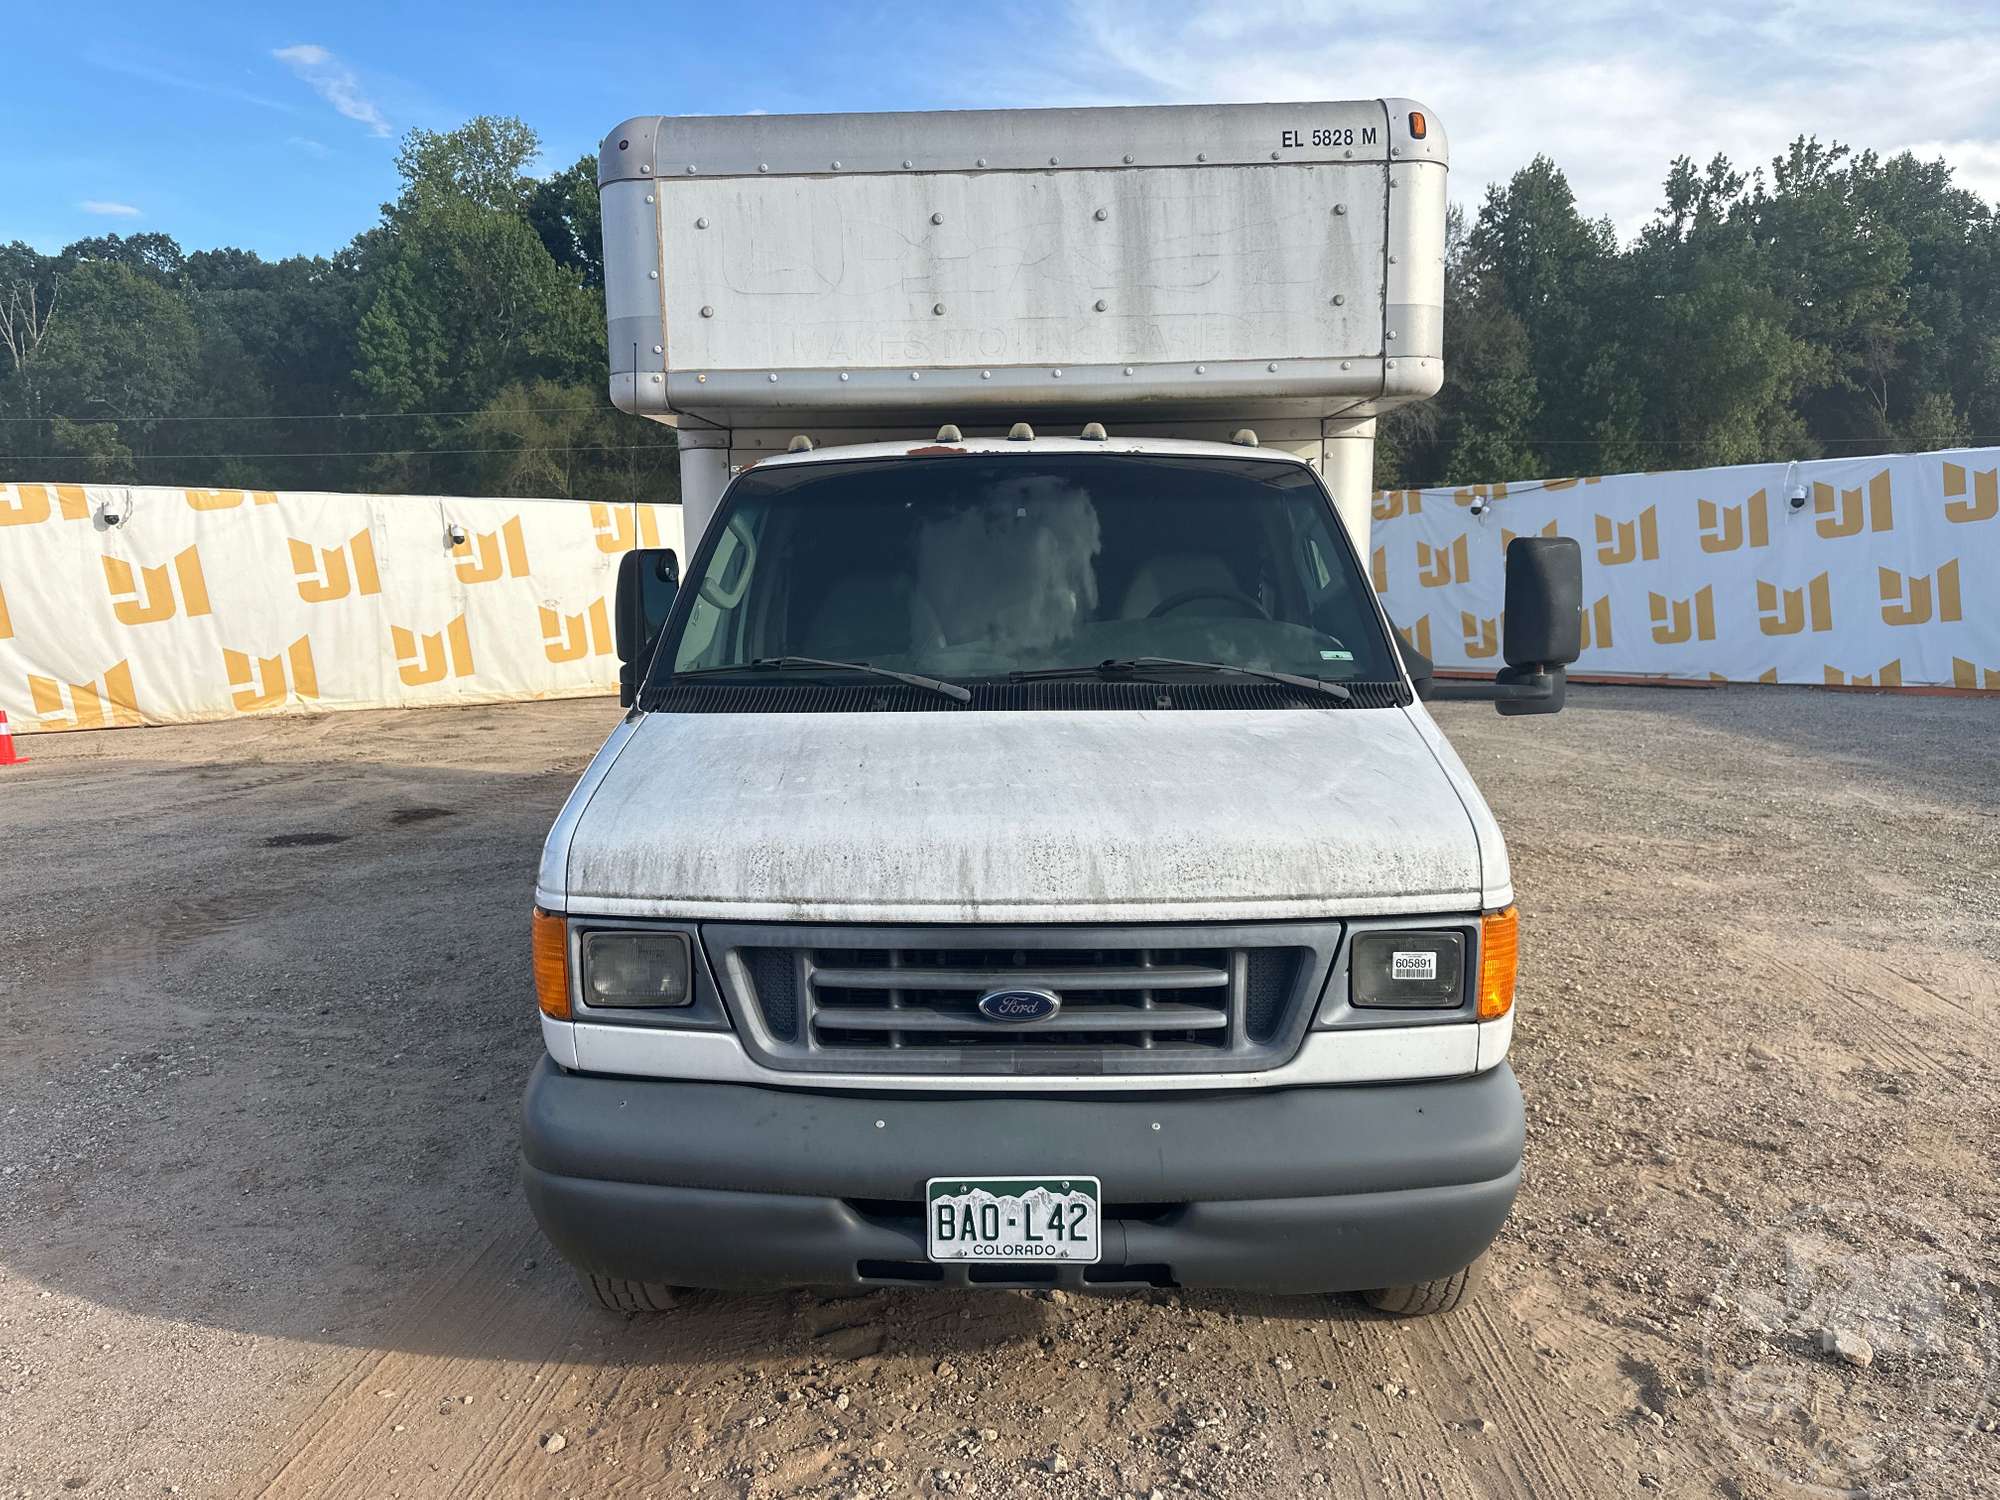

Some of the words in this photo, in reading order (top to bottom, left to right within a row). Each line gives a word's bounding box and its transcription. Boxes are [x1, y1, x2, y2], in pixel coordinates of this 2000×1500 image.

[1282, 130, 1304, 148] EL
[1312, 128, 1354, 147] 5828
[1362, 127, 1376, 145] M
[1395, 958, 1432, 968] 605891
[998, 996, 1039, 1014] Ford
[973, 1244, 1056, 1256] COLORADO
